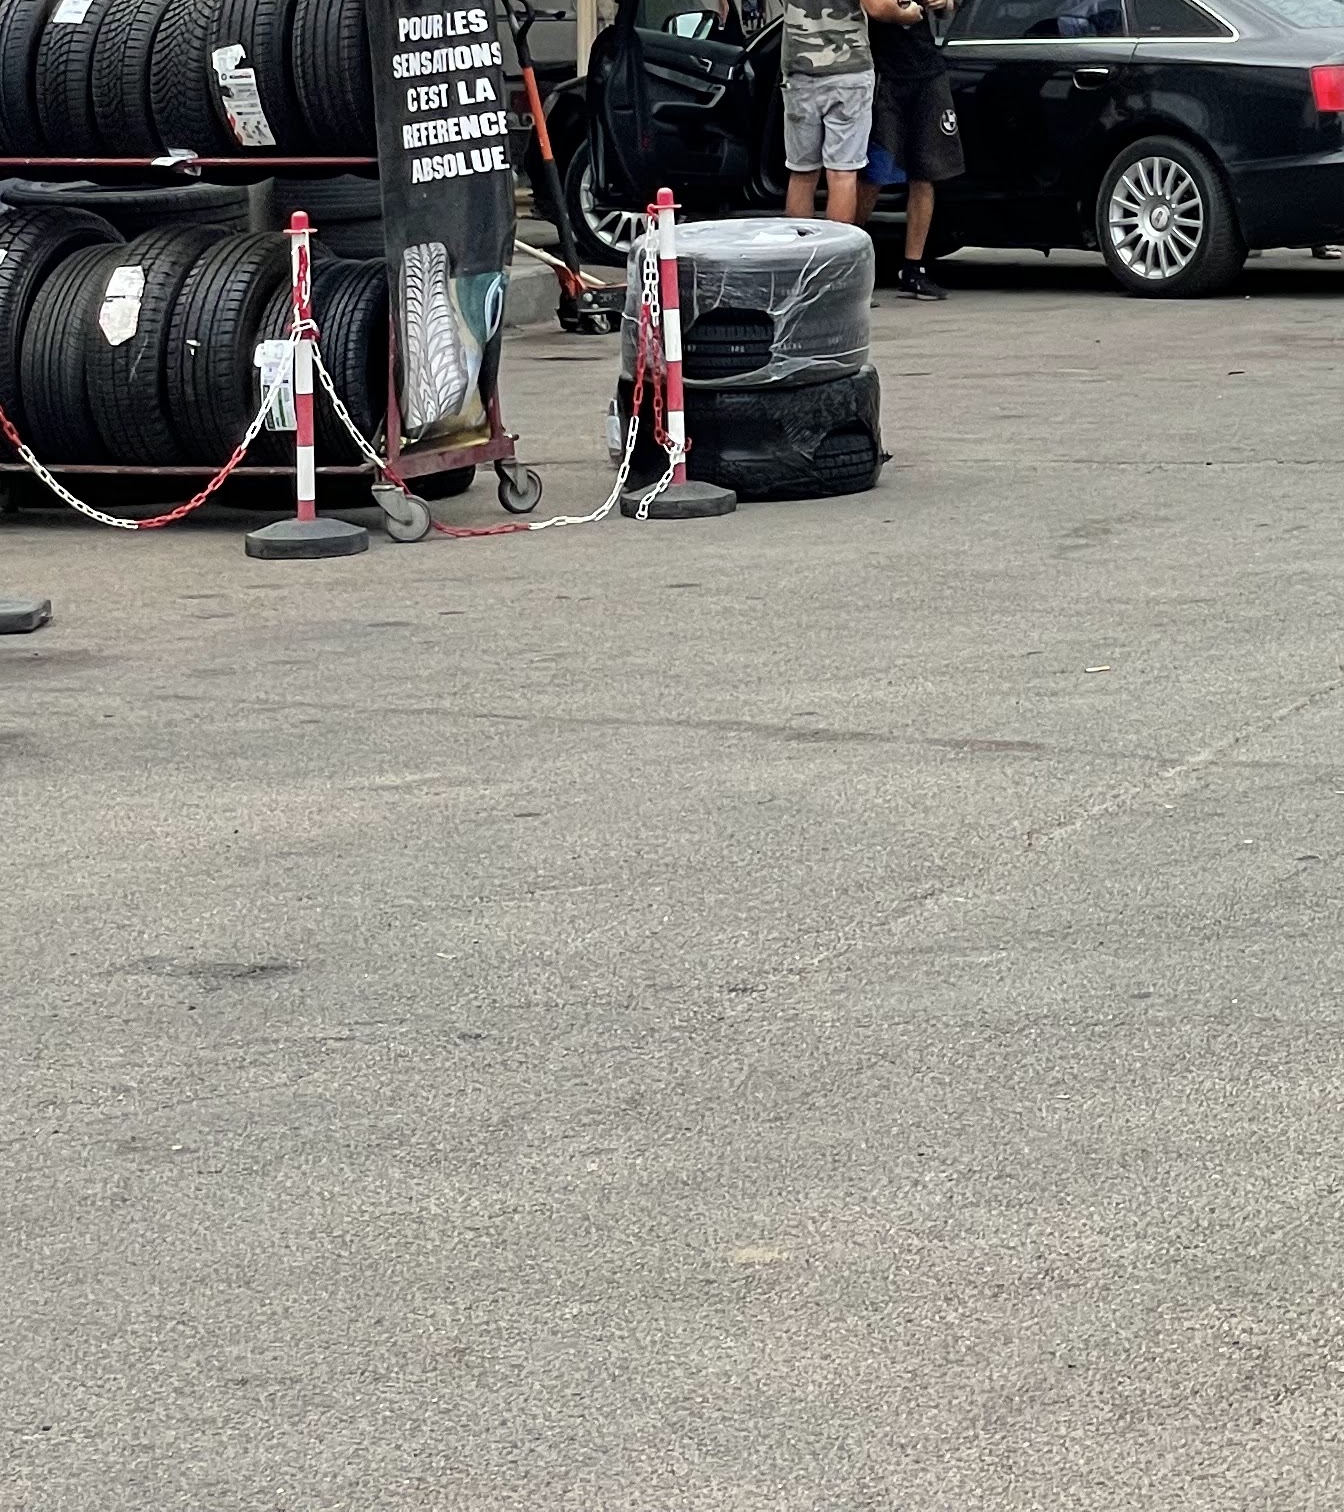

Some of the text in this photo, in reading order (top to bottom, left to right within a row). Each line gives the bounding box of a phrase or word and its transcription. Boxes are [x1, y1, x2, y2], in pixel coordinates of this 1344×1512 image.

[398, 8, 489, 43] POUR LES
[392, 41, 503, 79] SENSATIONS
[407, 77, 497, 113] C'EST LA
[402, 110, 509, 150] REFERENCE
